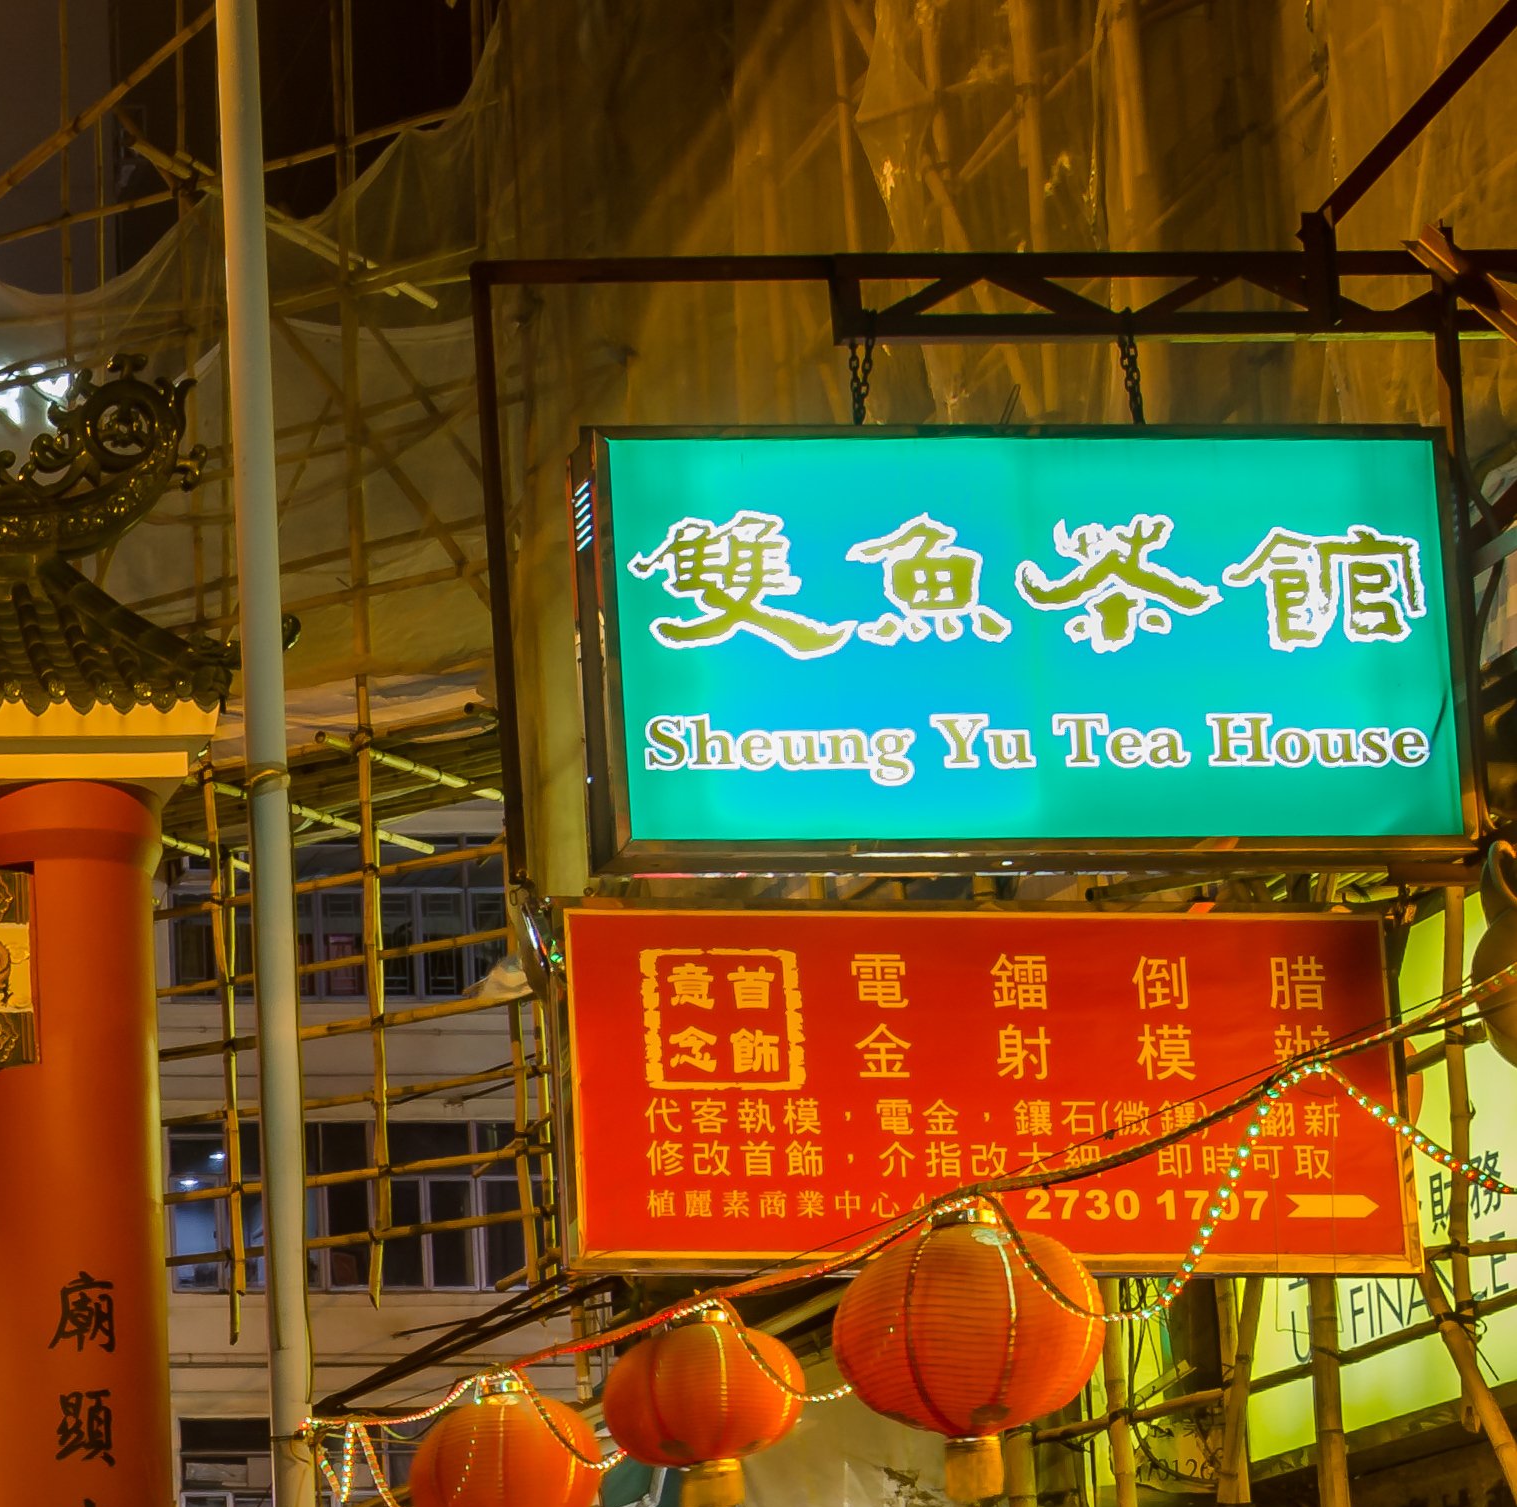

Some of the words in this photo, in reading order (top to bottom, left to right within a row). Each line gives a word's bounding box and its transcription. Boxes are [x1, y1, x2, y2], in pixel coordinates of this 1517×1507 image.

[629, 510, 1426, 660] 雙魚茶館
[644, 713, 916, 787] Sheung
[930, 712, 1037, 770] Yu
[1052, 712, 1189, 769] Tea
[1207, 712, 1430, 769] House
[646, 1189, 900, 1219] 植麗素商業中心
[1025, 1190, 1140, 1220] 2730
